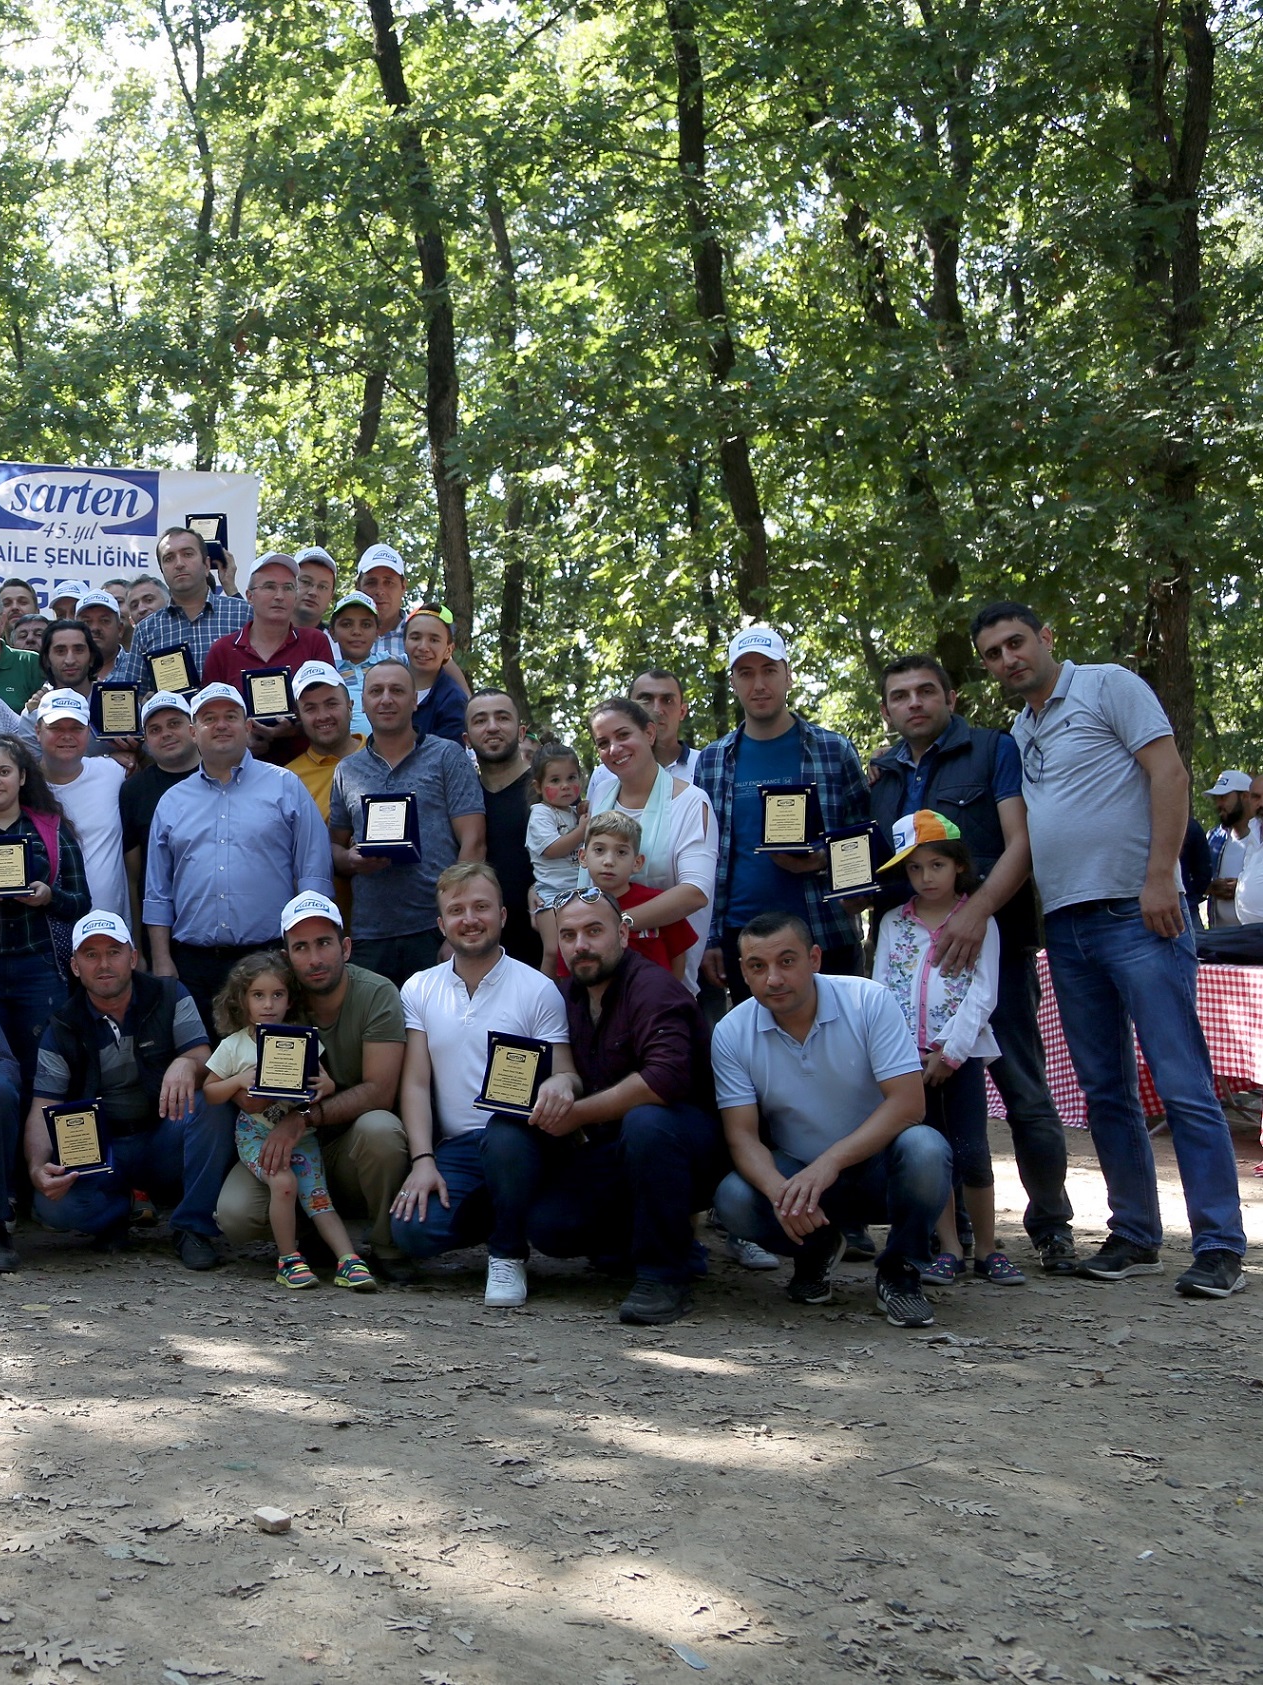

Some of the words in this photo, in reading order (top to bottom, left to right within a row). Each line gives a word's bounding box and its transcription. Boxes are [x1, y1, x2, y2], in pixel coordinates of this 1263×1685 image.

[10, 478, 140, 518] sarten
[42, 521, 99, 545] 45.yıl
[44, 545, 149, 569] ŞENLİĞİNE
